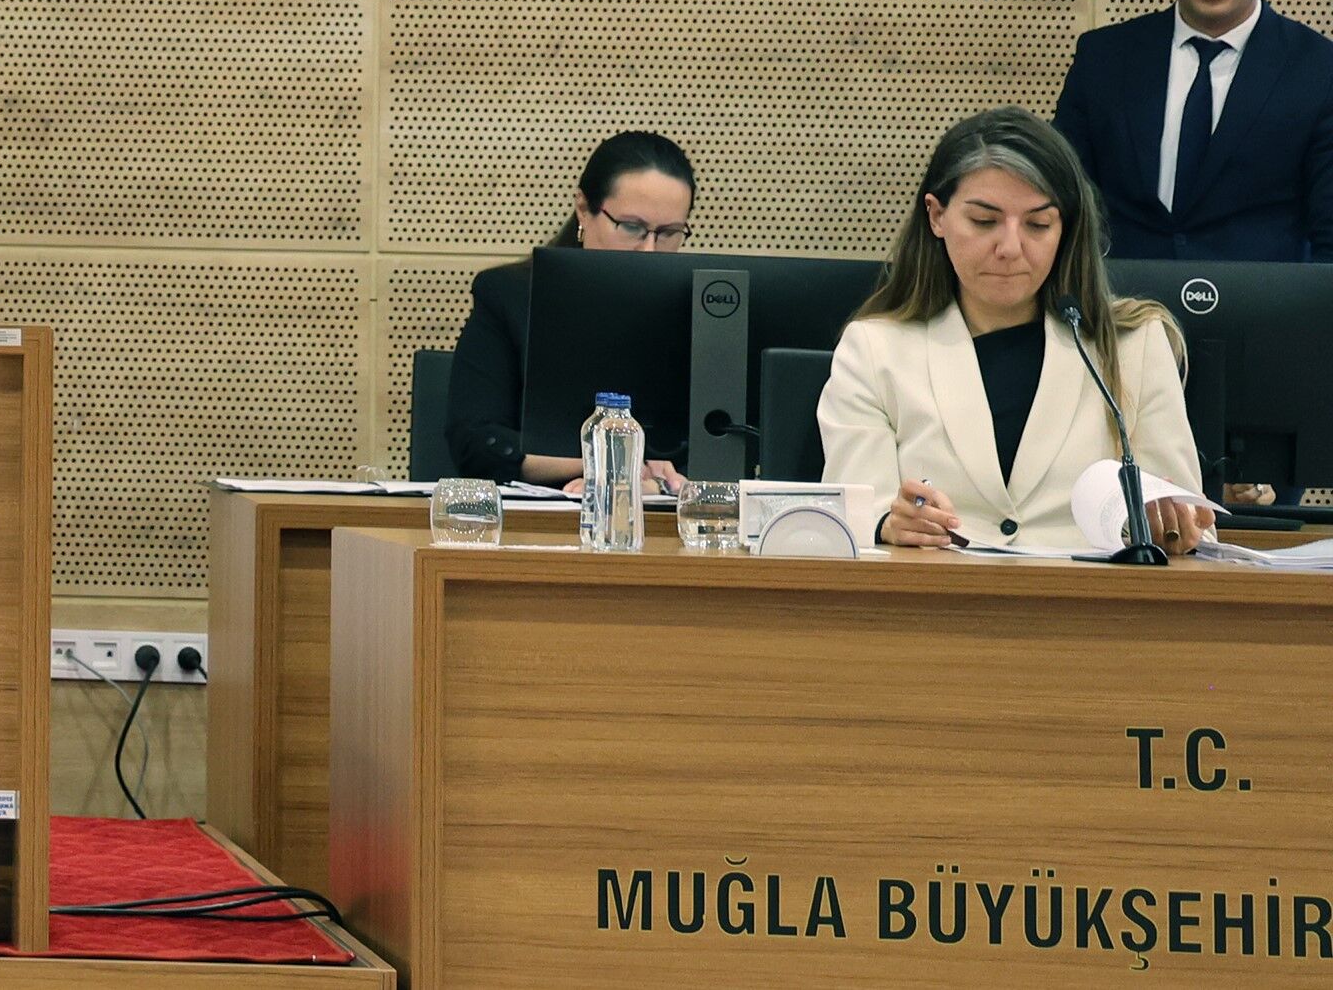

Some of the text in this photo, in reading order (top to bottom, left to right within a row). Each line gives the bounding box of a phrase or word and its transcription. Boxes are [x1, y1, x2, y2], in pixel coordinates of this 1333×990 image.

[706, 294, 736, 304] DELL
[1186, 291, 1215, 301] DELL
[1126, 728, 1252, 791] T.C.
[597, 856, 1333, 971] MUĞLA BÜYÜKŞEHİR
